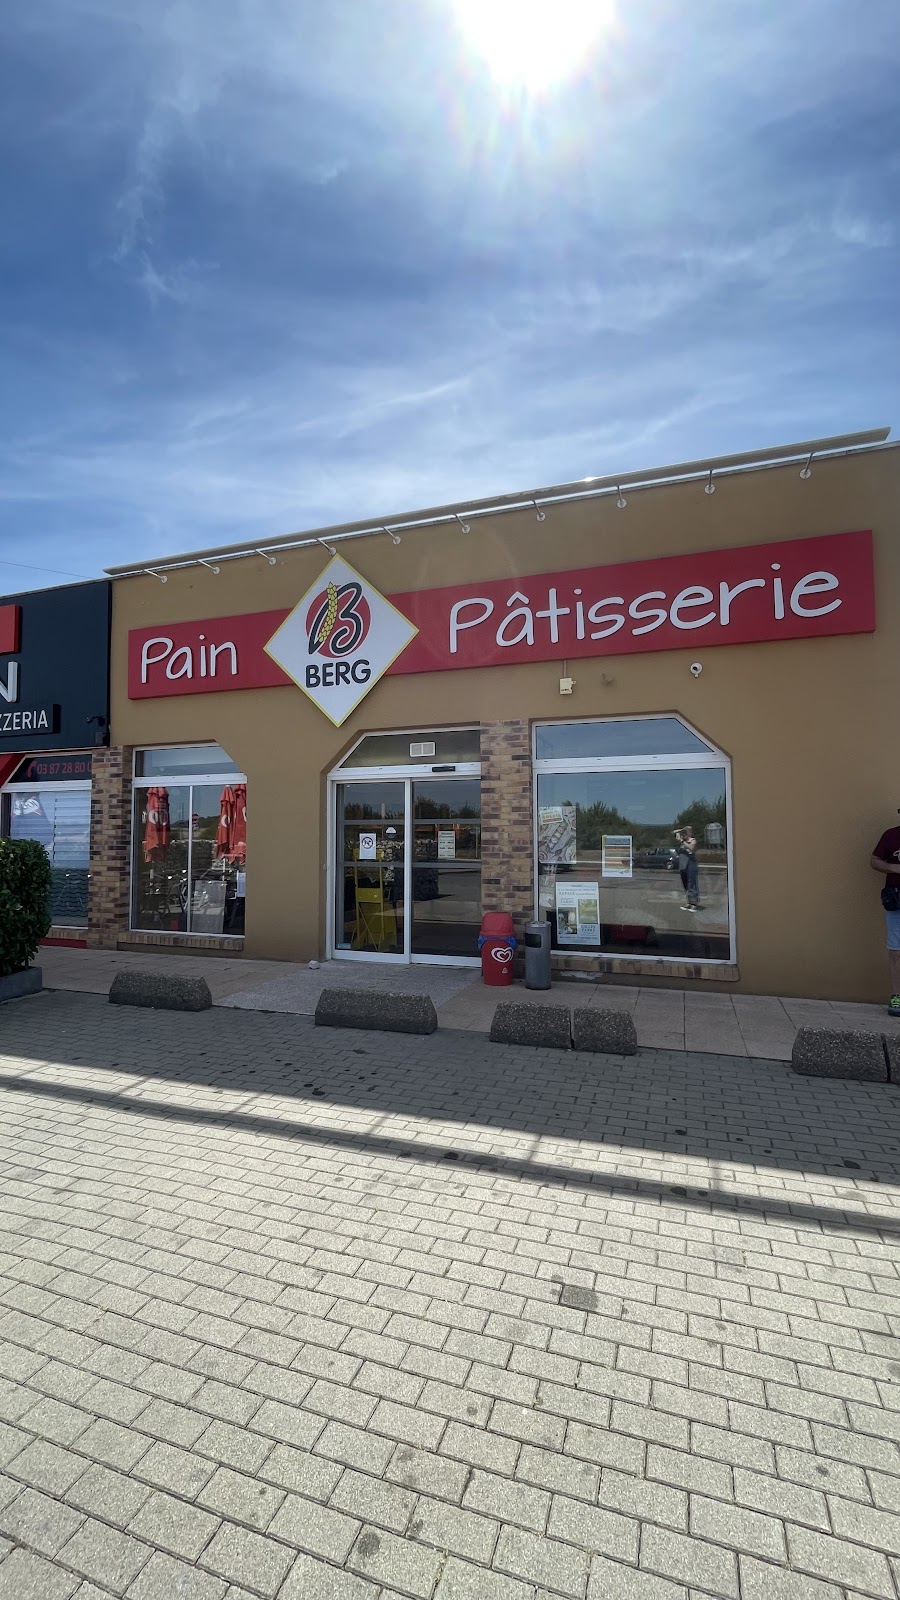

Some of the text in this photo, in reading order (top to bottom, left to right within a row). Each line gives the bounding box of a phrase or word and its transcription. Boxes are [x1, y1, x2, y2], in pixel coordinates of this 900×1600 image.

[448, 562, 843, 654] Pâtisserie
[140, 634, 238, 684] Pain
[305, 658, 372, 688] BERG
[36, 763, 48, 775] 03
[49, 762, 60, 774] 87
[62, 762, 73, 773] 28
[75, 761, 86, 773] 80
